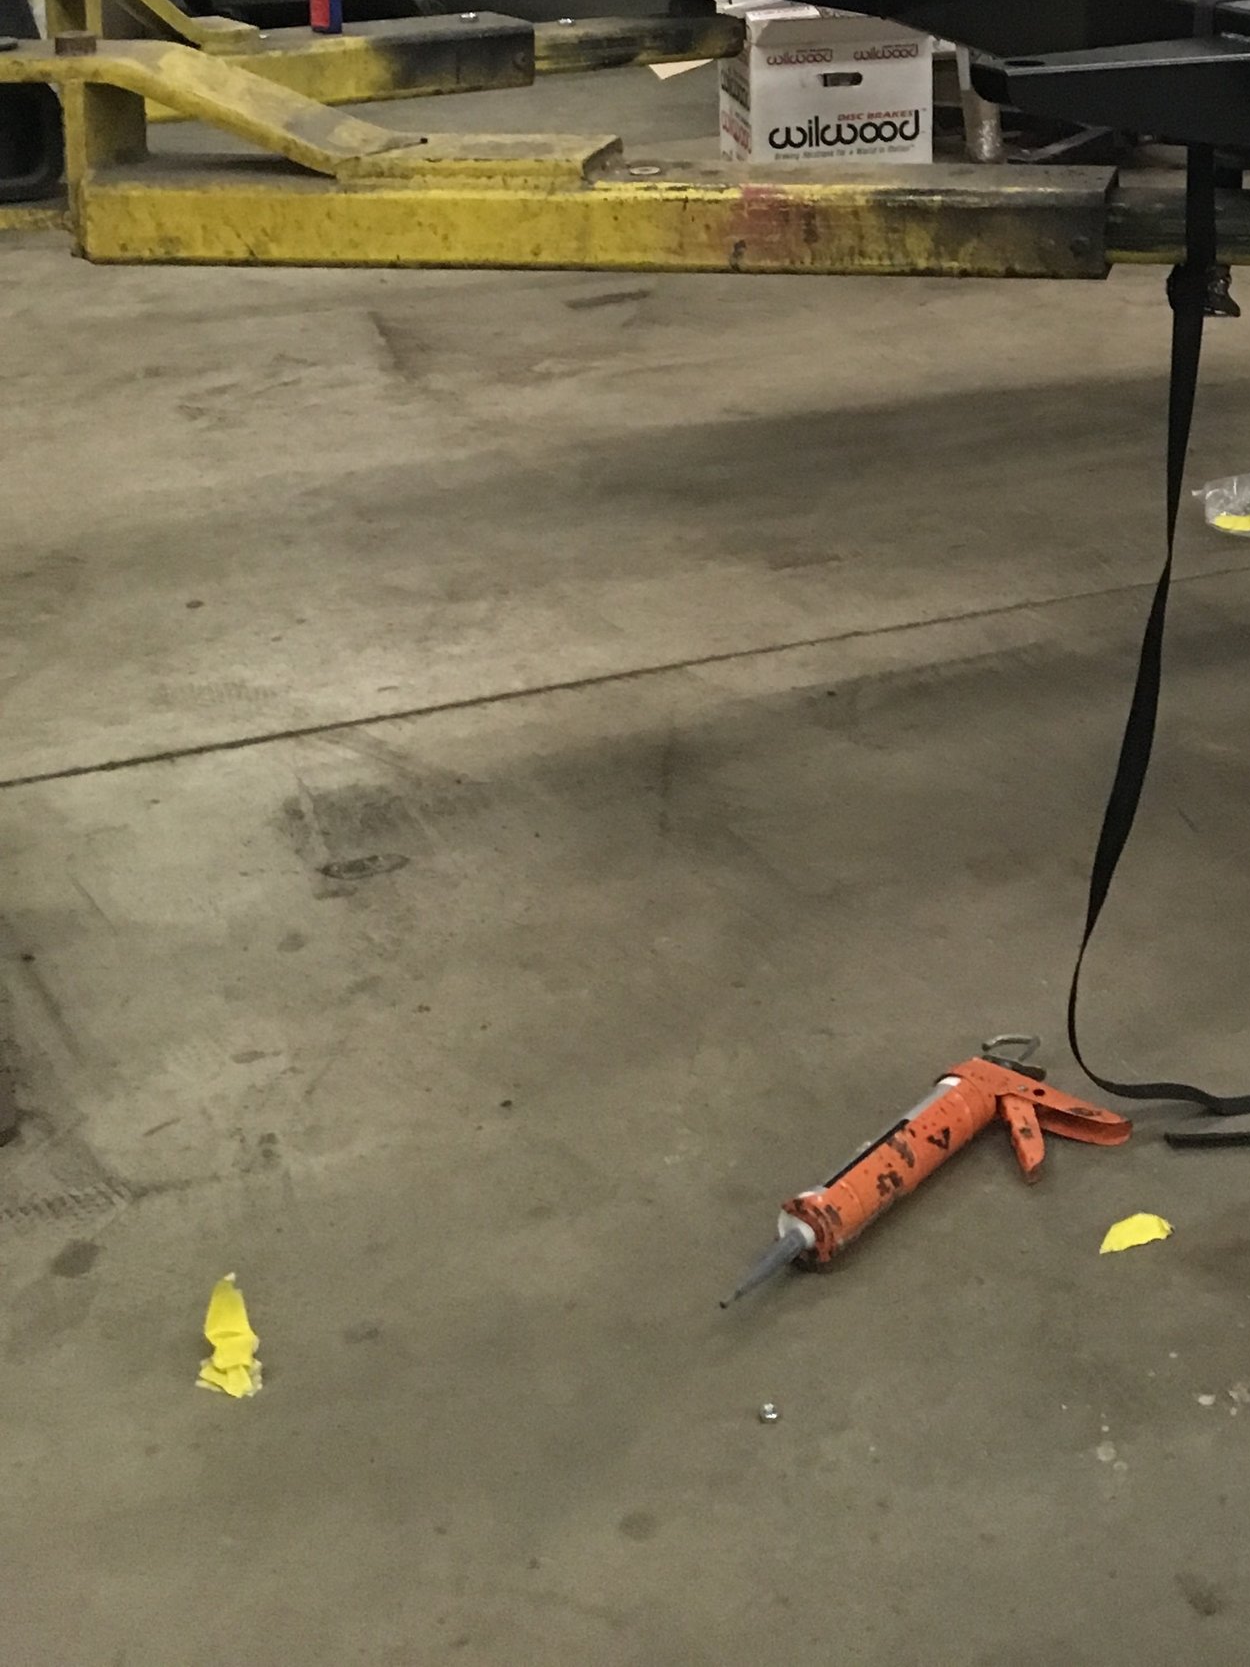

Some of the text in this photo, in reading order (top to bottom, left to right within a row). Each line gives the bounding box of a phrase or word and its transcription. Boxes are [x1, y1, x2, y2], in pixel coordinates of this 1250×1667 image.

[767, 49, 833, 66] wilwood
[853, 44, 919, 61] wilwood
[838, 110, 913, 121] DISC BRAKES
[768, 109, 920, 149] wilwood
